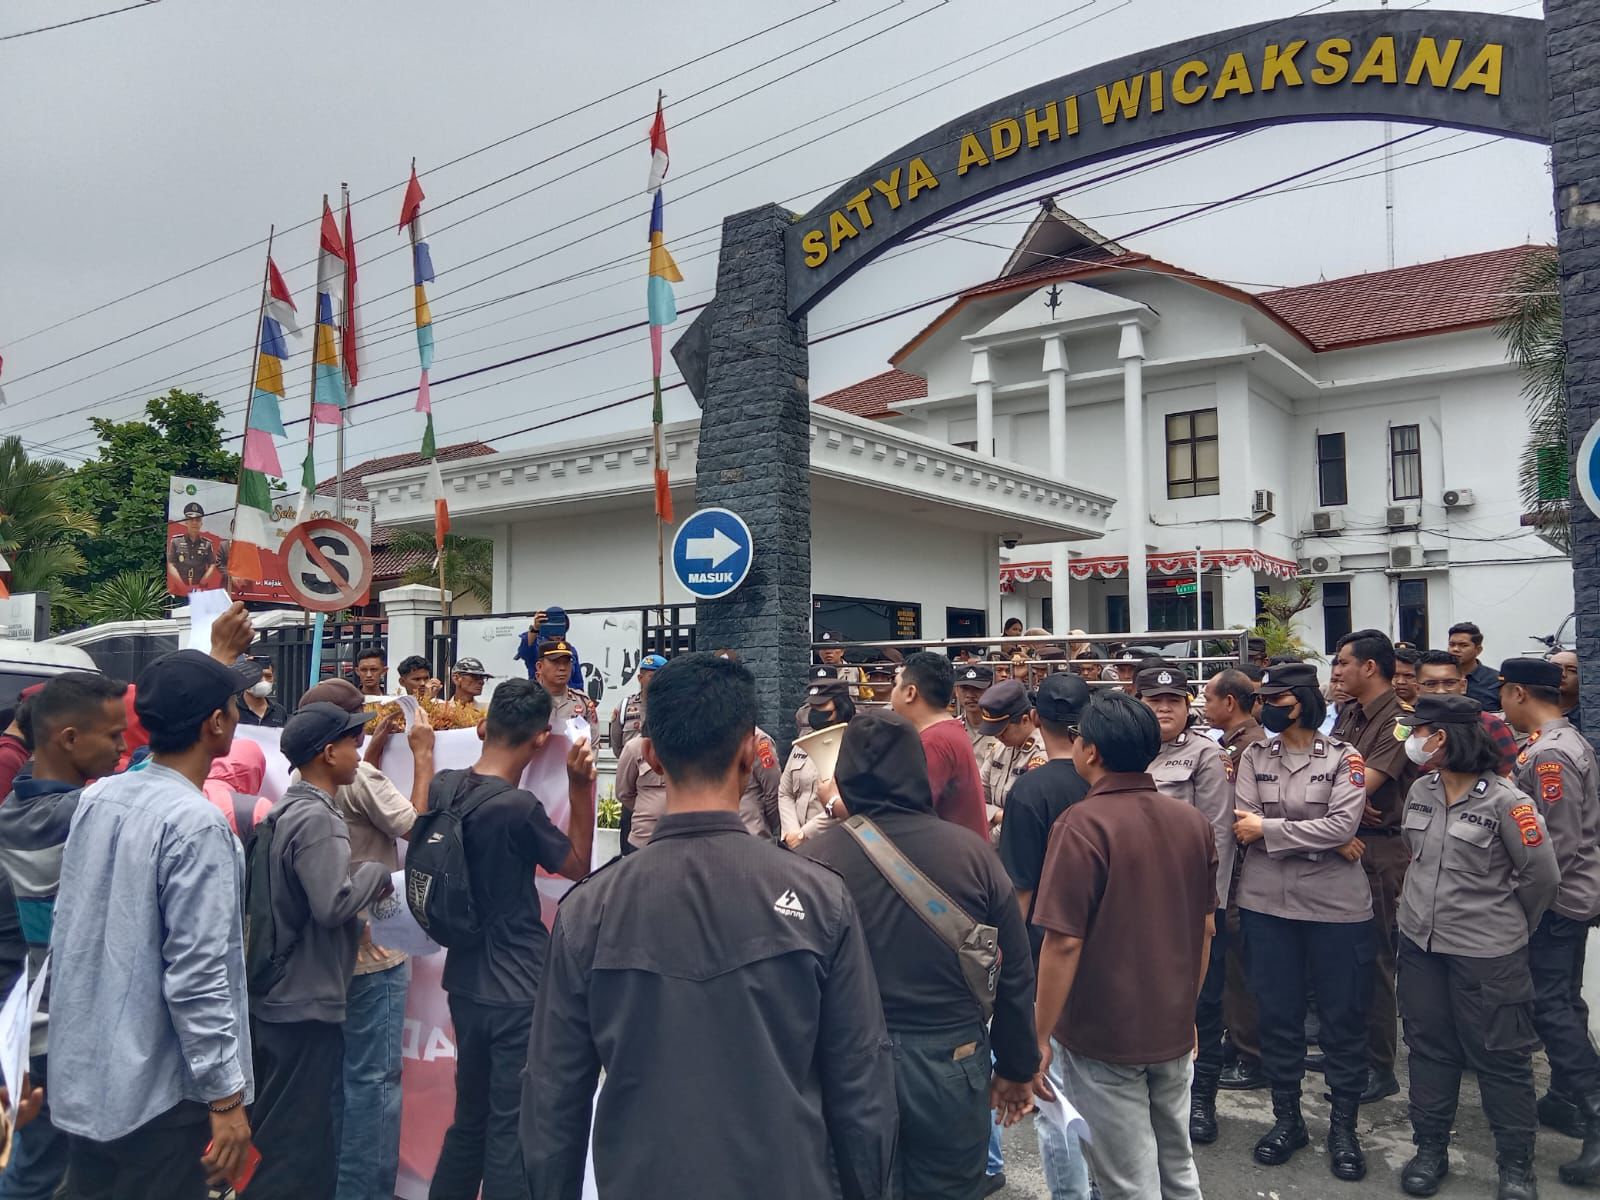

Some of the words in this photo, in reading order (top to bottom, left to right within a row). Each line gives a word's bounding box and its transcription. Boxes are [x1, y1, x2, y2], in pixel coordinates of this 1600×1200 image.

[802, 157, 939, 268] SATYA
[957, 94, 1079, 176] ADHI
[1095, 35, 1503, 125] WICAKSANA
[301, 536, 349, 594] S
[688, 572, 733, 583] MASUK
[1165, 759, 1193, 767] POLRI
[1460, 812, 1497, 830] POLRI
